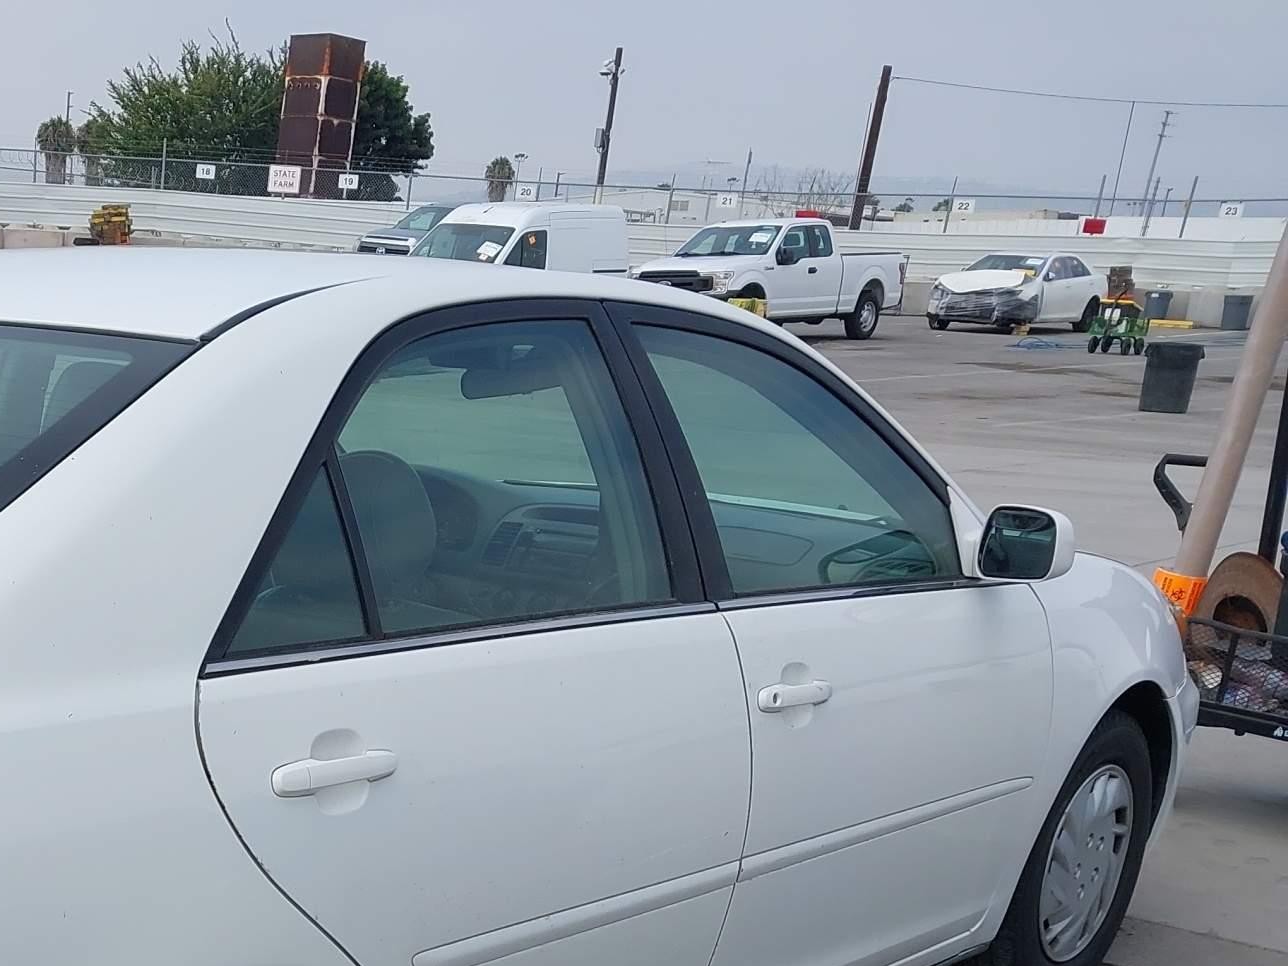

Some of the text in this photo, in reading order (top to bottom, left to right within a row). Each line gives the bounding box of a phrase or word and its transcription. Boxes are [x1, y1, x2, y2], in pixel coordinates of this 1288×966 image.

[200, 167, 211, 176] 18
[273, 169, 297, 179] STATE
[273, 180, 294, 188] FARM
[343, 177, 354, 186] 19
[520, 187, 532, 197] 20
[722, 197, 732, 206] 21
[957, 202, 970, 211] 22
[1224, 206, 1238, 216] 23
